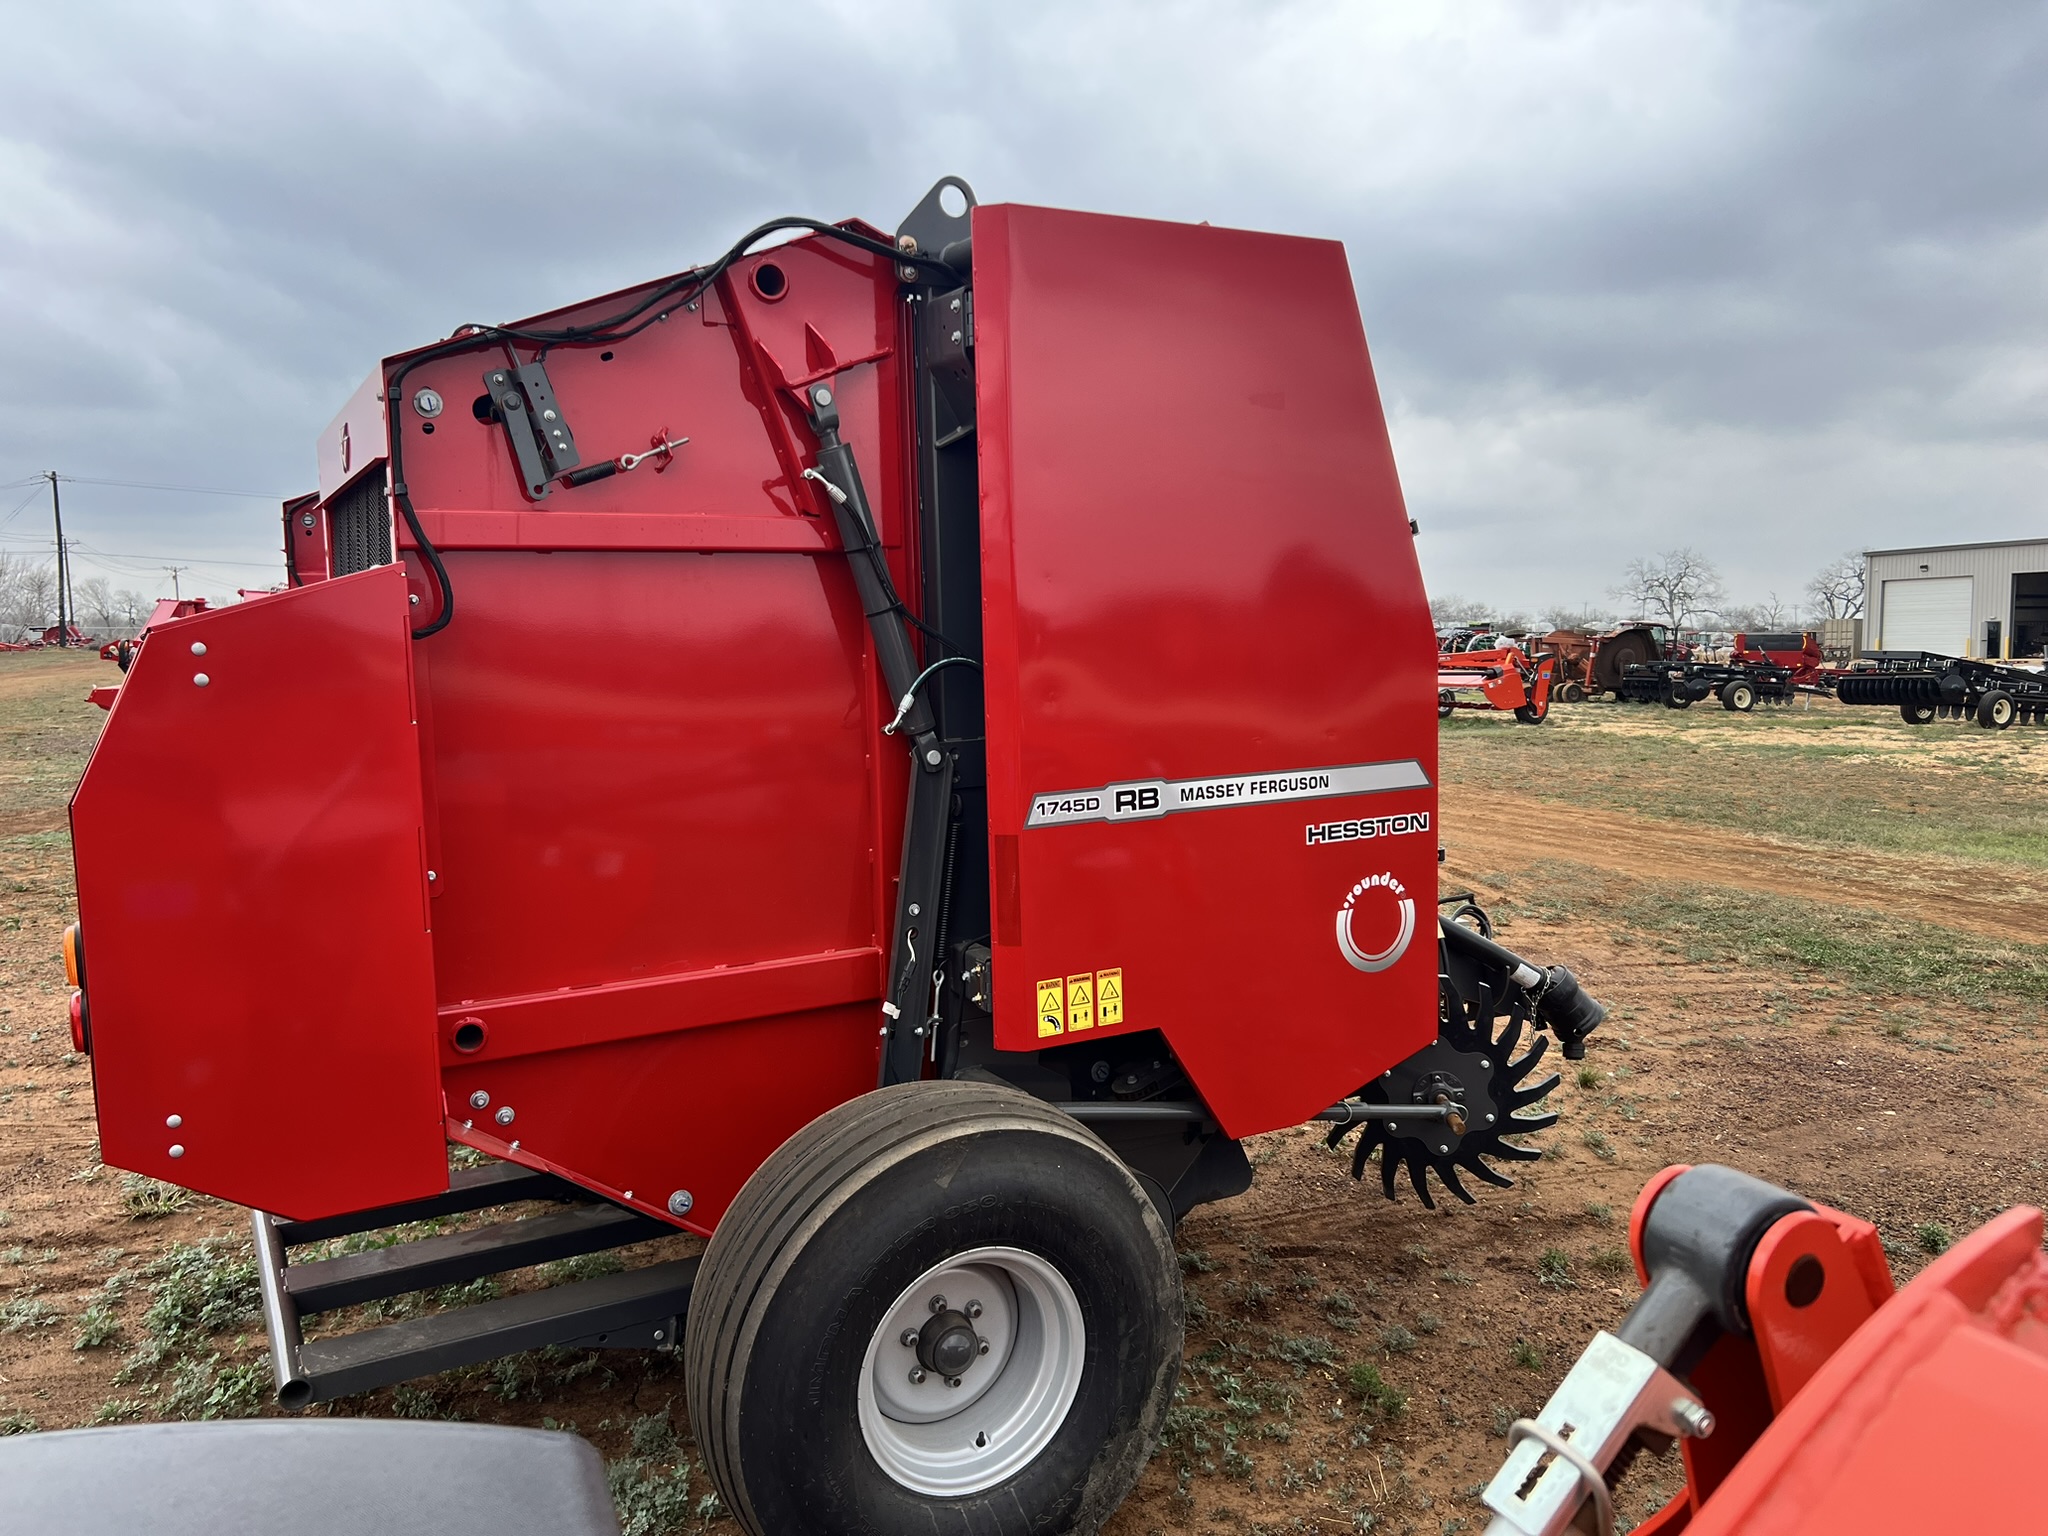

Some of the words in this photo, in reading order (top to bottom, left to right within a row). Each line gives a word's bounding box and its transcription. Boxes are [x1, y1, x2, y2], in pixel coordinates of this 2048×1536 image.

[1035, 797, 1100, 817] 1745D
[1115, 787, 1160, 813] RB
[1180, 782, 1245, 802] MASSEY
[1250, 774, 1330, 795] FERGUSON
[1306, 812, 1429, 845] HESSTON
